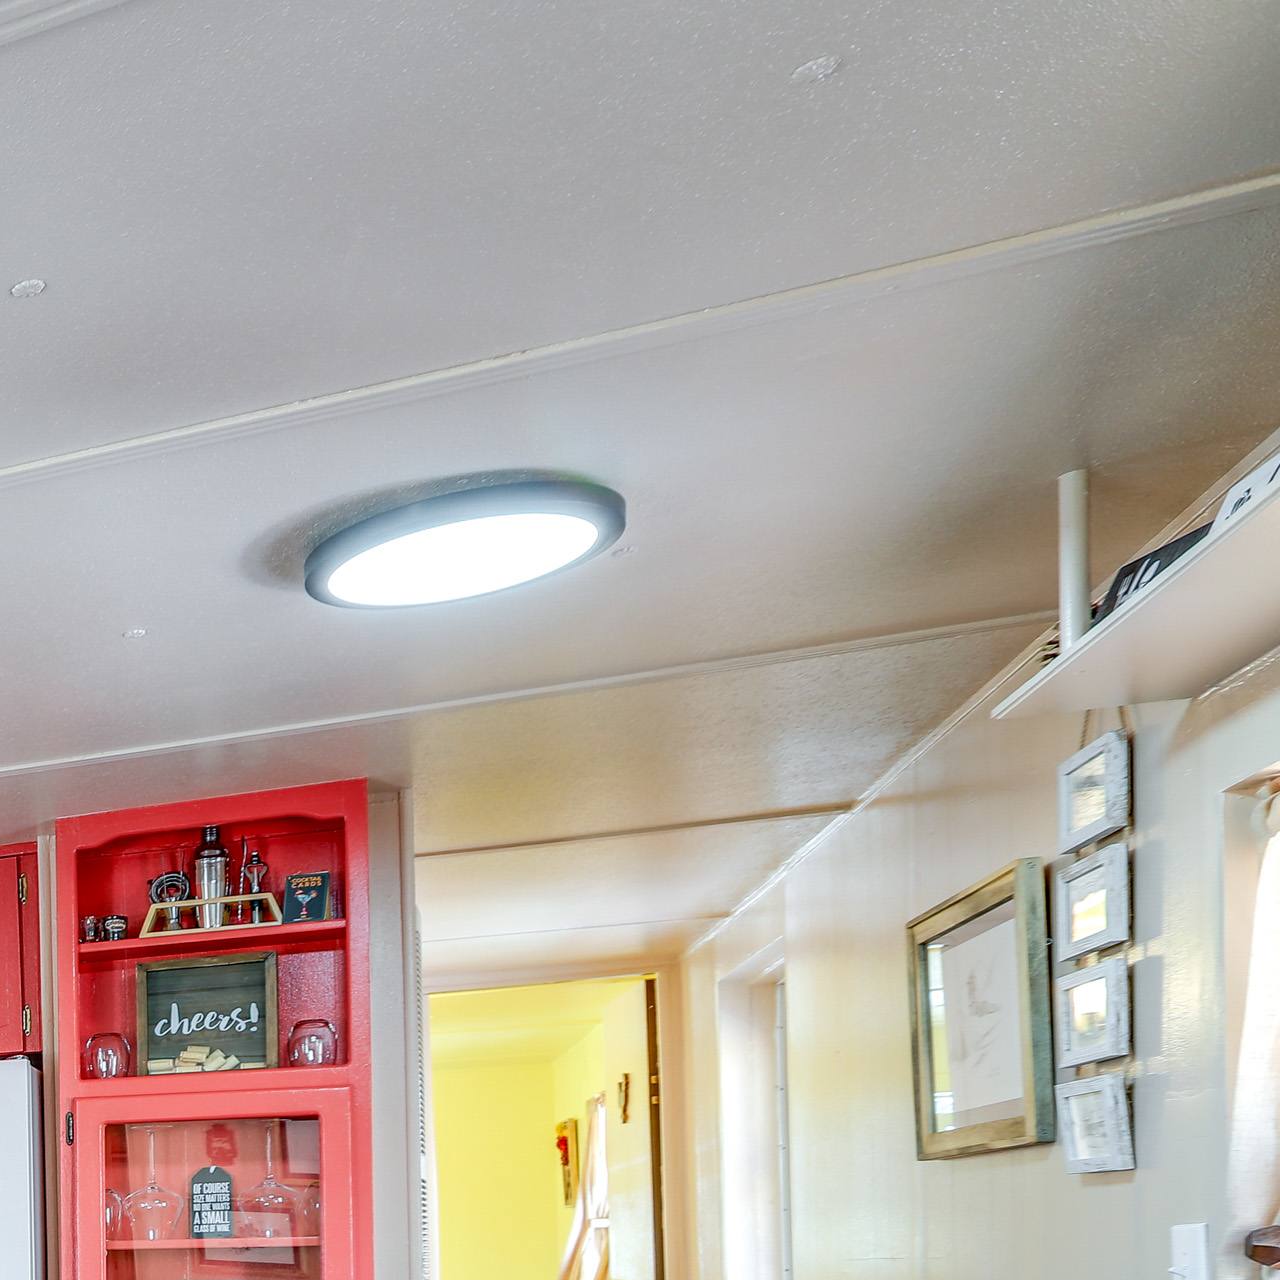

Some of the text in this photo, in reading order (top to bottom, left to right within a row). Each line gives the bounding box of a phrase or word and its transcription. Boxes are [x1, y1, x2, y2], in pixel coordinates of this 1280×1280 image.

[291, 881, 322, 889] CARDS
[154, 1002, 259, 1037] cheers!
[193, 1181, 231, 1194] OF COURSE
[193, 1193, 231, 1203] SIZE MATTERS
[193, 1210, 230, 1225] A SMALL
[193, 1224, 209, 1233] GLASS
[216, 1223, 231, 1232] WINE
